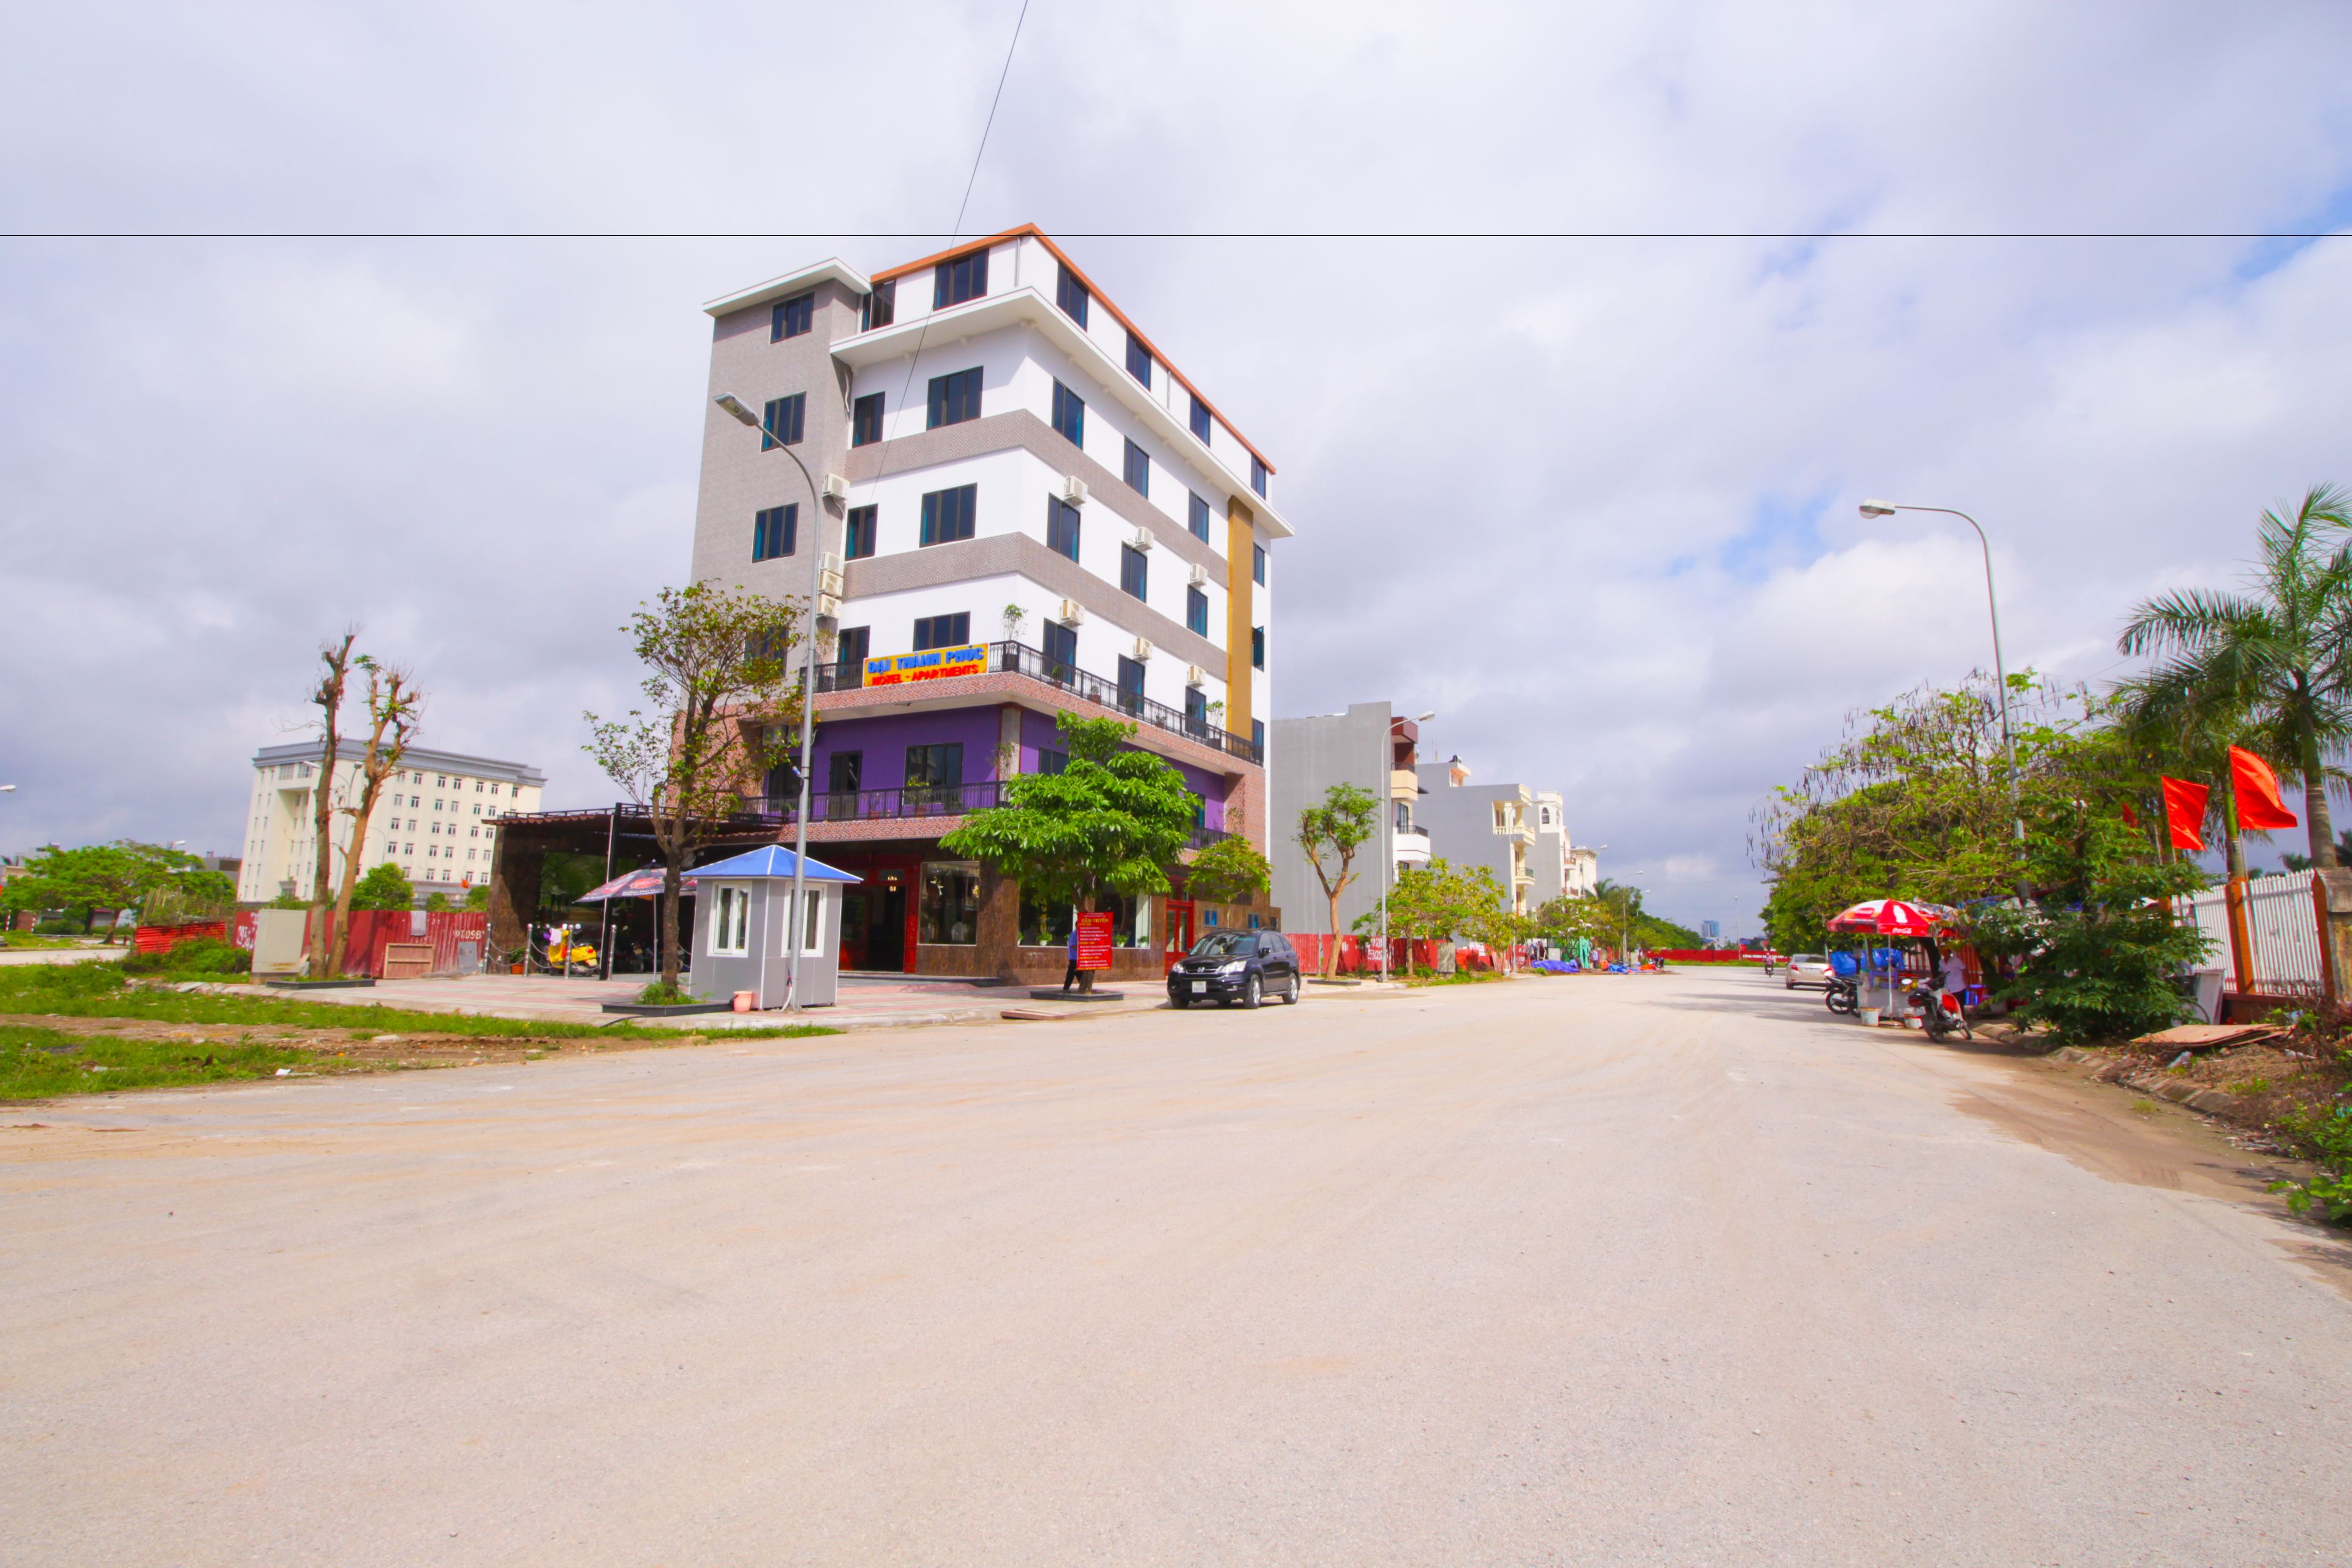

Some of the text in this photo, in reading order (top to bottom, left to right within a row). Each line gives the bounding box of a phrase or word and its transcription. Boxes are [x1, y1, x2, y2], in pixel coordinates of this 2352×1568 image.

[896, 652, 941, 670] THÀNH
[945, 645, 984, 664] PHÚC
[872, 674, 903, 686] HOTEL
[911, 664, 979, 681] APARTMENTS
